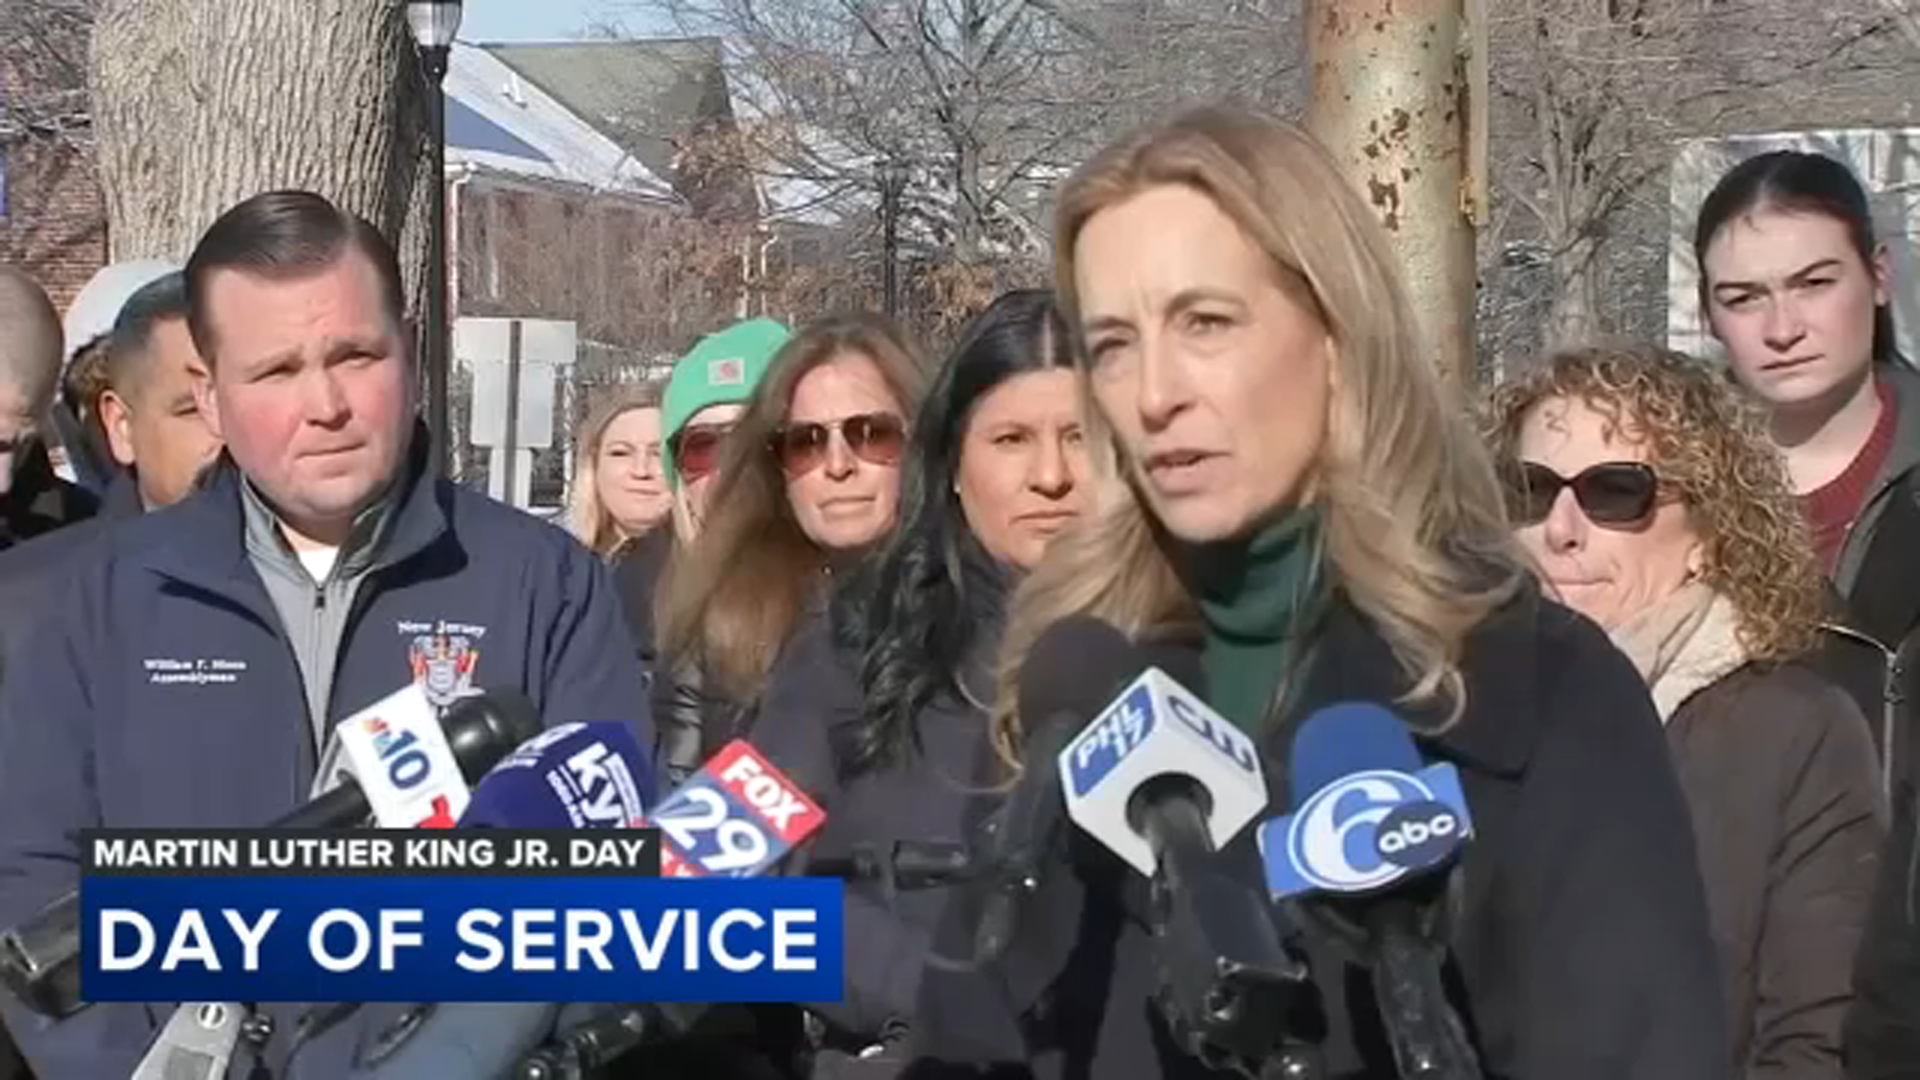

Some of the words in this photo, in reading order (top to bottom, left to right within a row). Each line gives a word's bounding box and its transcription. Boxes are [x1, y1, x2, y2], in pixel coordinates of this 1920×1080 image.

[397, 620, 432, 635] New
[436, 619, 487, 639] Jersey
[381, 729, 431, 790] 10
[1076, 701, 1143, 770] PHL
[1116, 712, 1146, 758] 17
[720, 754, 808, 832] FOX
[652, 786, 768, 871] 29
[1303, 779, 1402, 885] 6
[1378, 813, 1456, 854] abc
